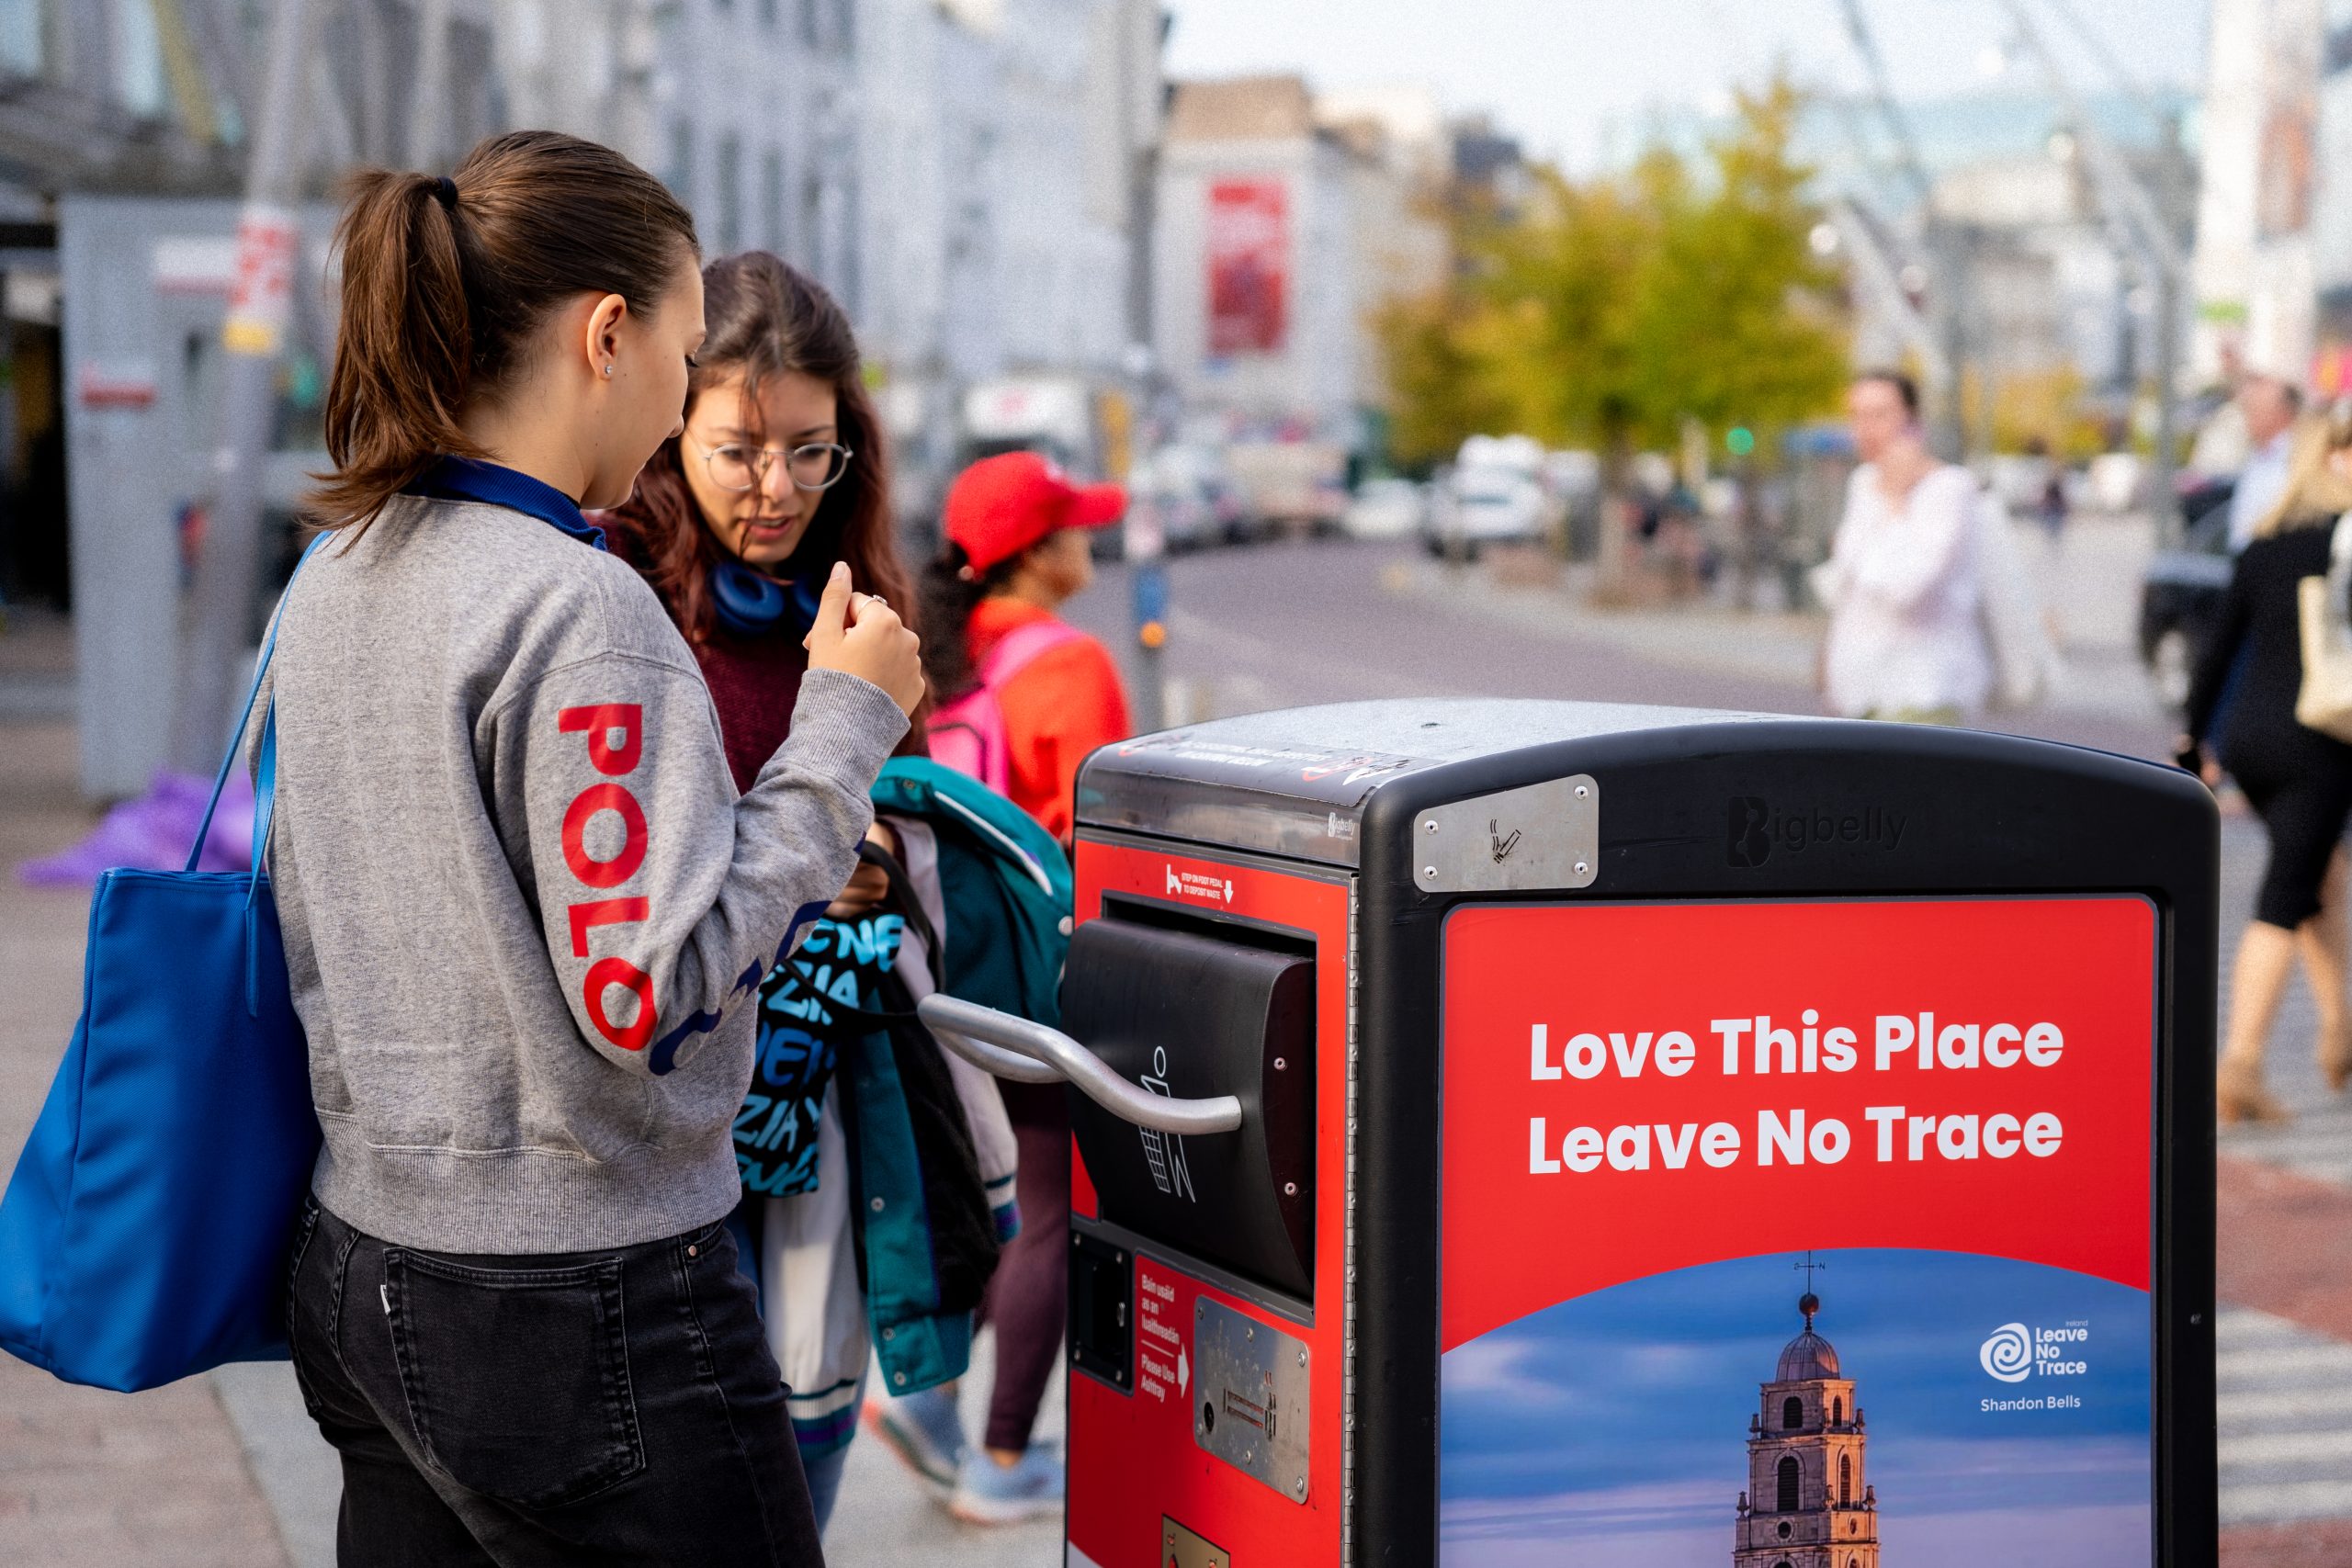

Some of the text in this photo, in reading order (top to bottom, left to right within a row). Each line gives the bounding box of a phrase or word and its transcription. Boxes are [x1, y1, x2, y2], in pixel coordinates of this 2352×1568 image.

[1727, 796, 1907, 868] Bigbelly
[558, 703, 658, 1051] POLO
[1531, 1009, 2064, 1079] Love This Place
[1530, 1106, 2063, 1174] Leave No Trace
[1142, 1274, 1157, 1294] Bain
[2036, 1327, 2087, 1343] Leave
[2036, 1344, 2060, 1359] No
[1142, 1353, 1175, 1383] Please Use
[2036, 1359, 2086, 1375] Trace
[1141, 1374, 1165, 1403] Ashtray
[1981, 1394, 2081, 1412] Shandon Bells
